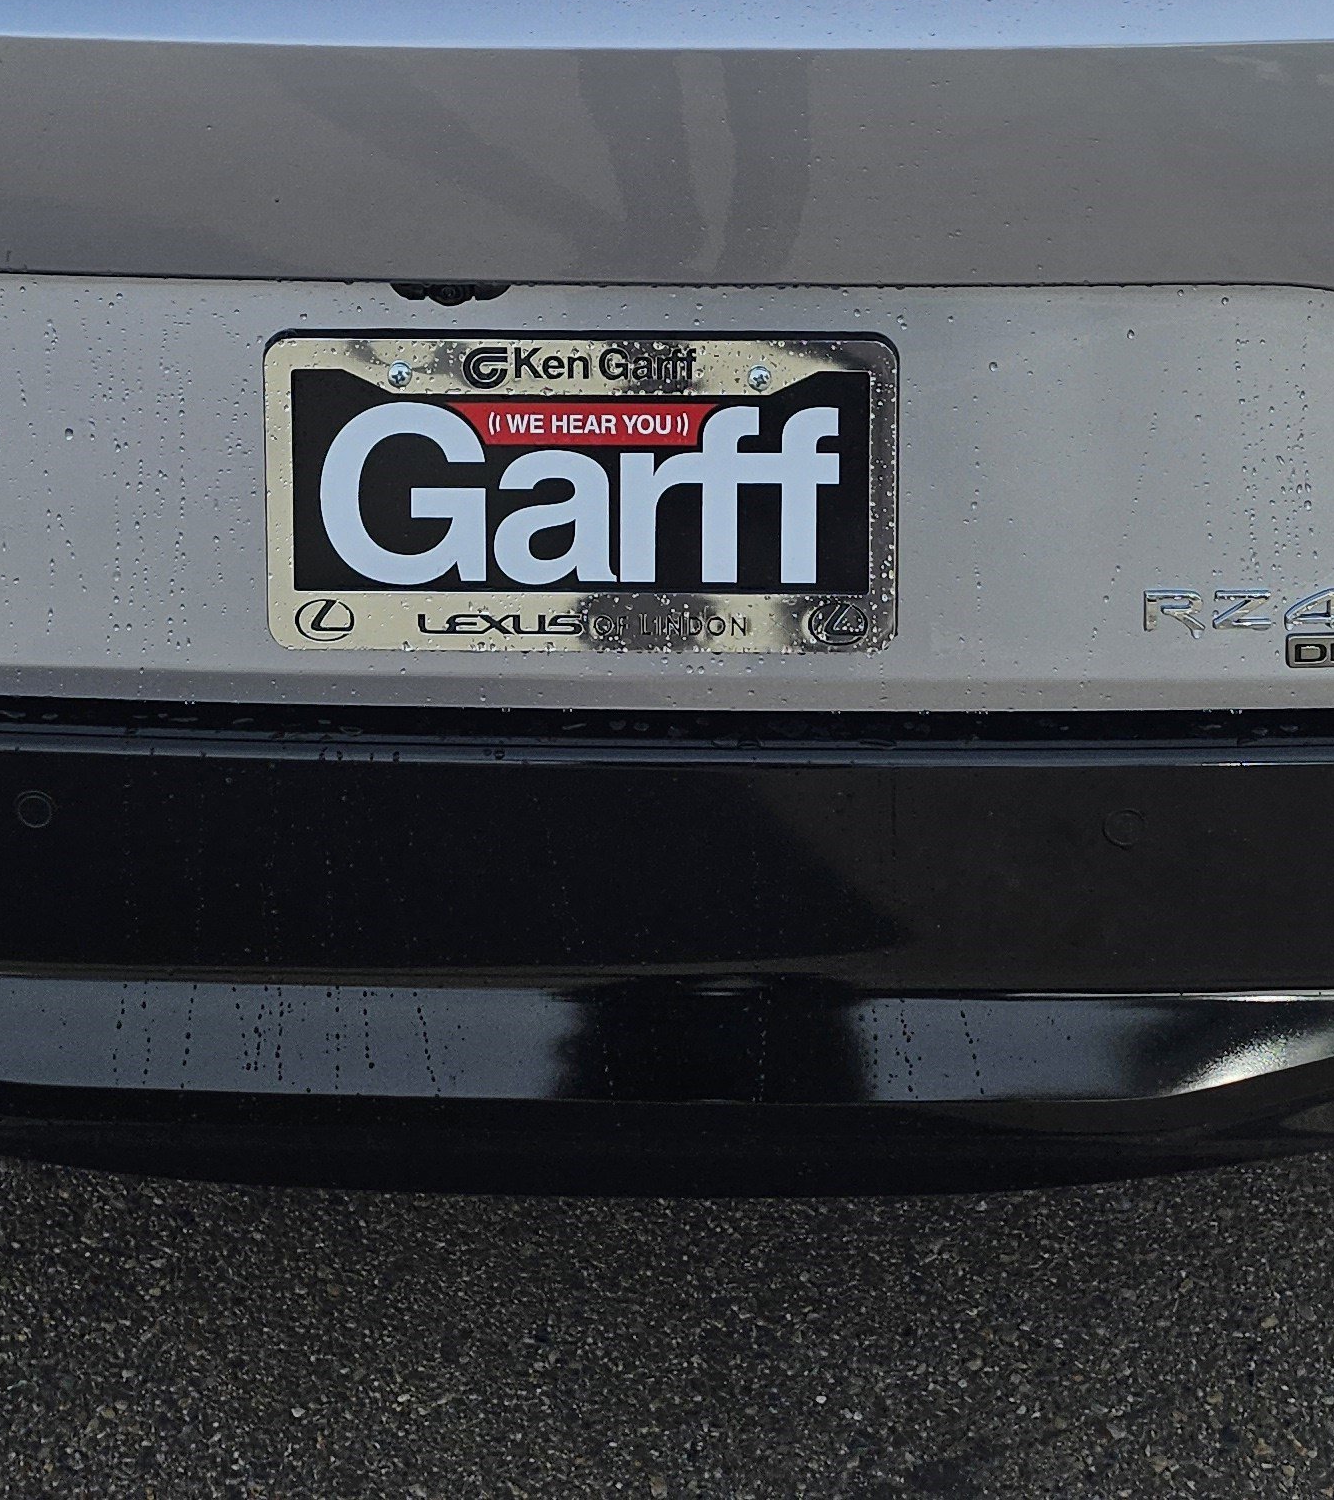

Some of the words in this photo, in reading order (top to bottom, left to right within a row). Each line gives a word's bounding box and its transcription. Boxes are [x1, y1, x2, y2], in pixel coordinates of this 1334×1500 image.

[514, 347, 590, 380] Ken
[598, 347, 697, 382] Garff
[506, 414, 544, 434] WE
[551, 414, 617, 434] HEAR
[623, 414, 672, 435] YOU
[319, 401, 840, 585] Garff
[417, 613, 584, 635] LEXUS
[593, 615, 628, 636] OF
[638, 612, 749, 637] LINDON
